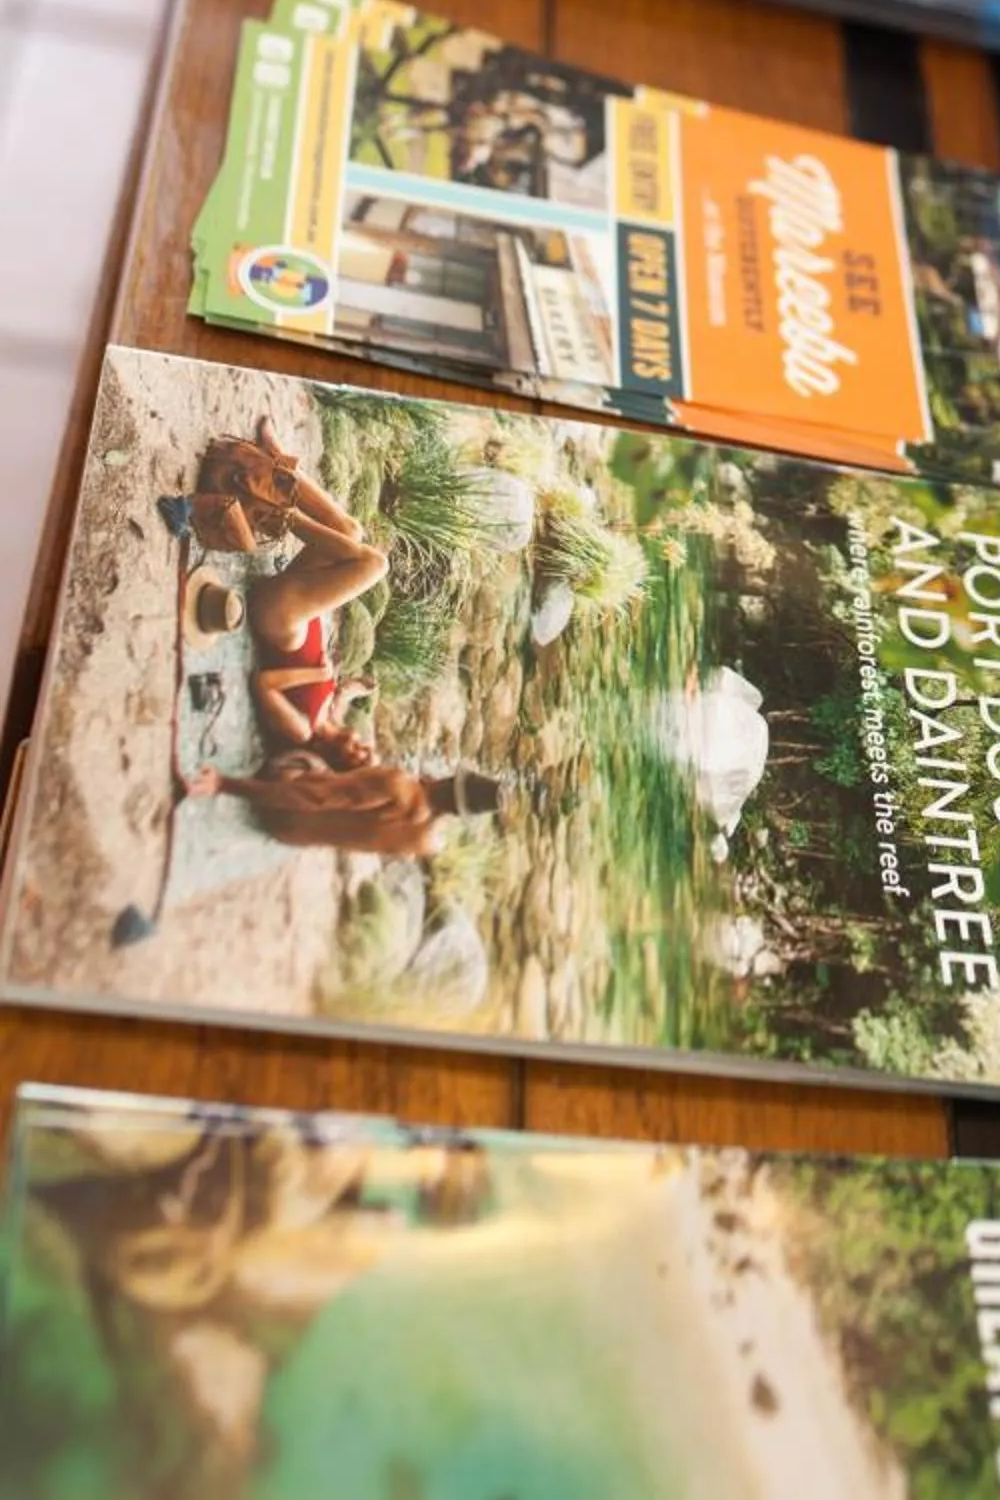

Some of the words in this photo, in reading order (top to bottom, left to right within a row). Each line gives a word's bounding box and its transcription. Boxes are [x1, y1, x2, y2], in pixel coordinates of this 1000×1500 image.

[628, 233, 667, 296] OPEN
[747, 154, 858, 397] Mareeba
[844, 250, 881, 317] SEE
[631, 296, 671, 318] 7
[630, 318, 672, 382] DAYS
[847, 512, 868, 580] where
[890, 516, 951, 650] AND
[853, 586, 884, 706] rainforest
[864, 707, 890, 784] meets
[873, 792, 900, 835] the
[904, 667, 1000, 988] DAINTREE
[878, 842, 910, 898] reef
